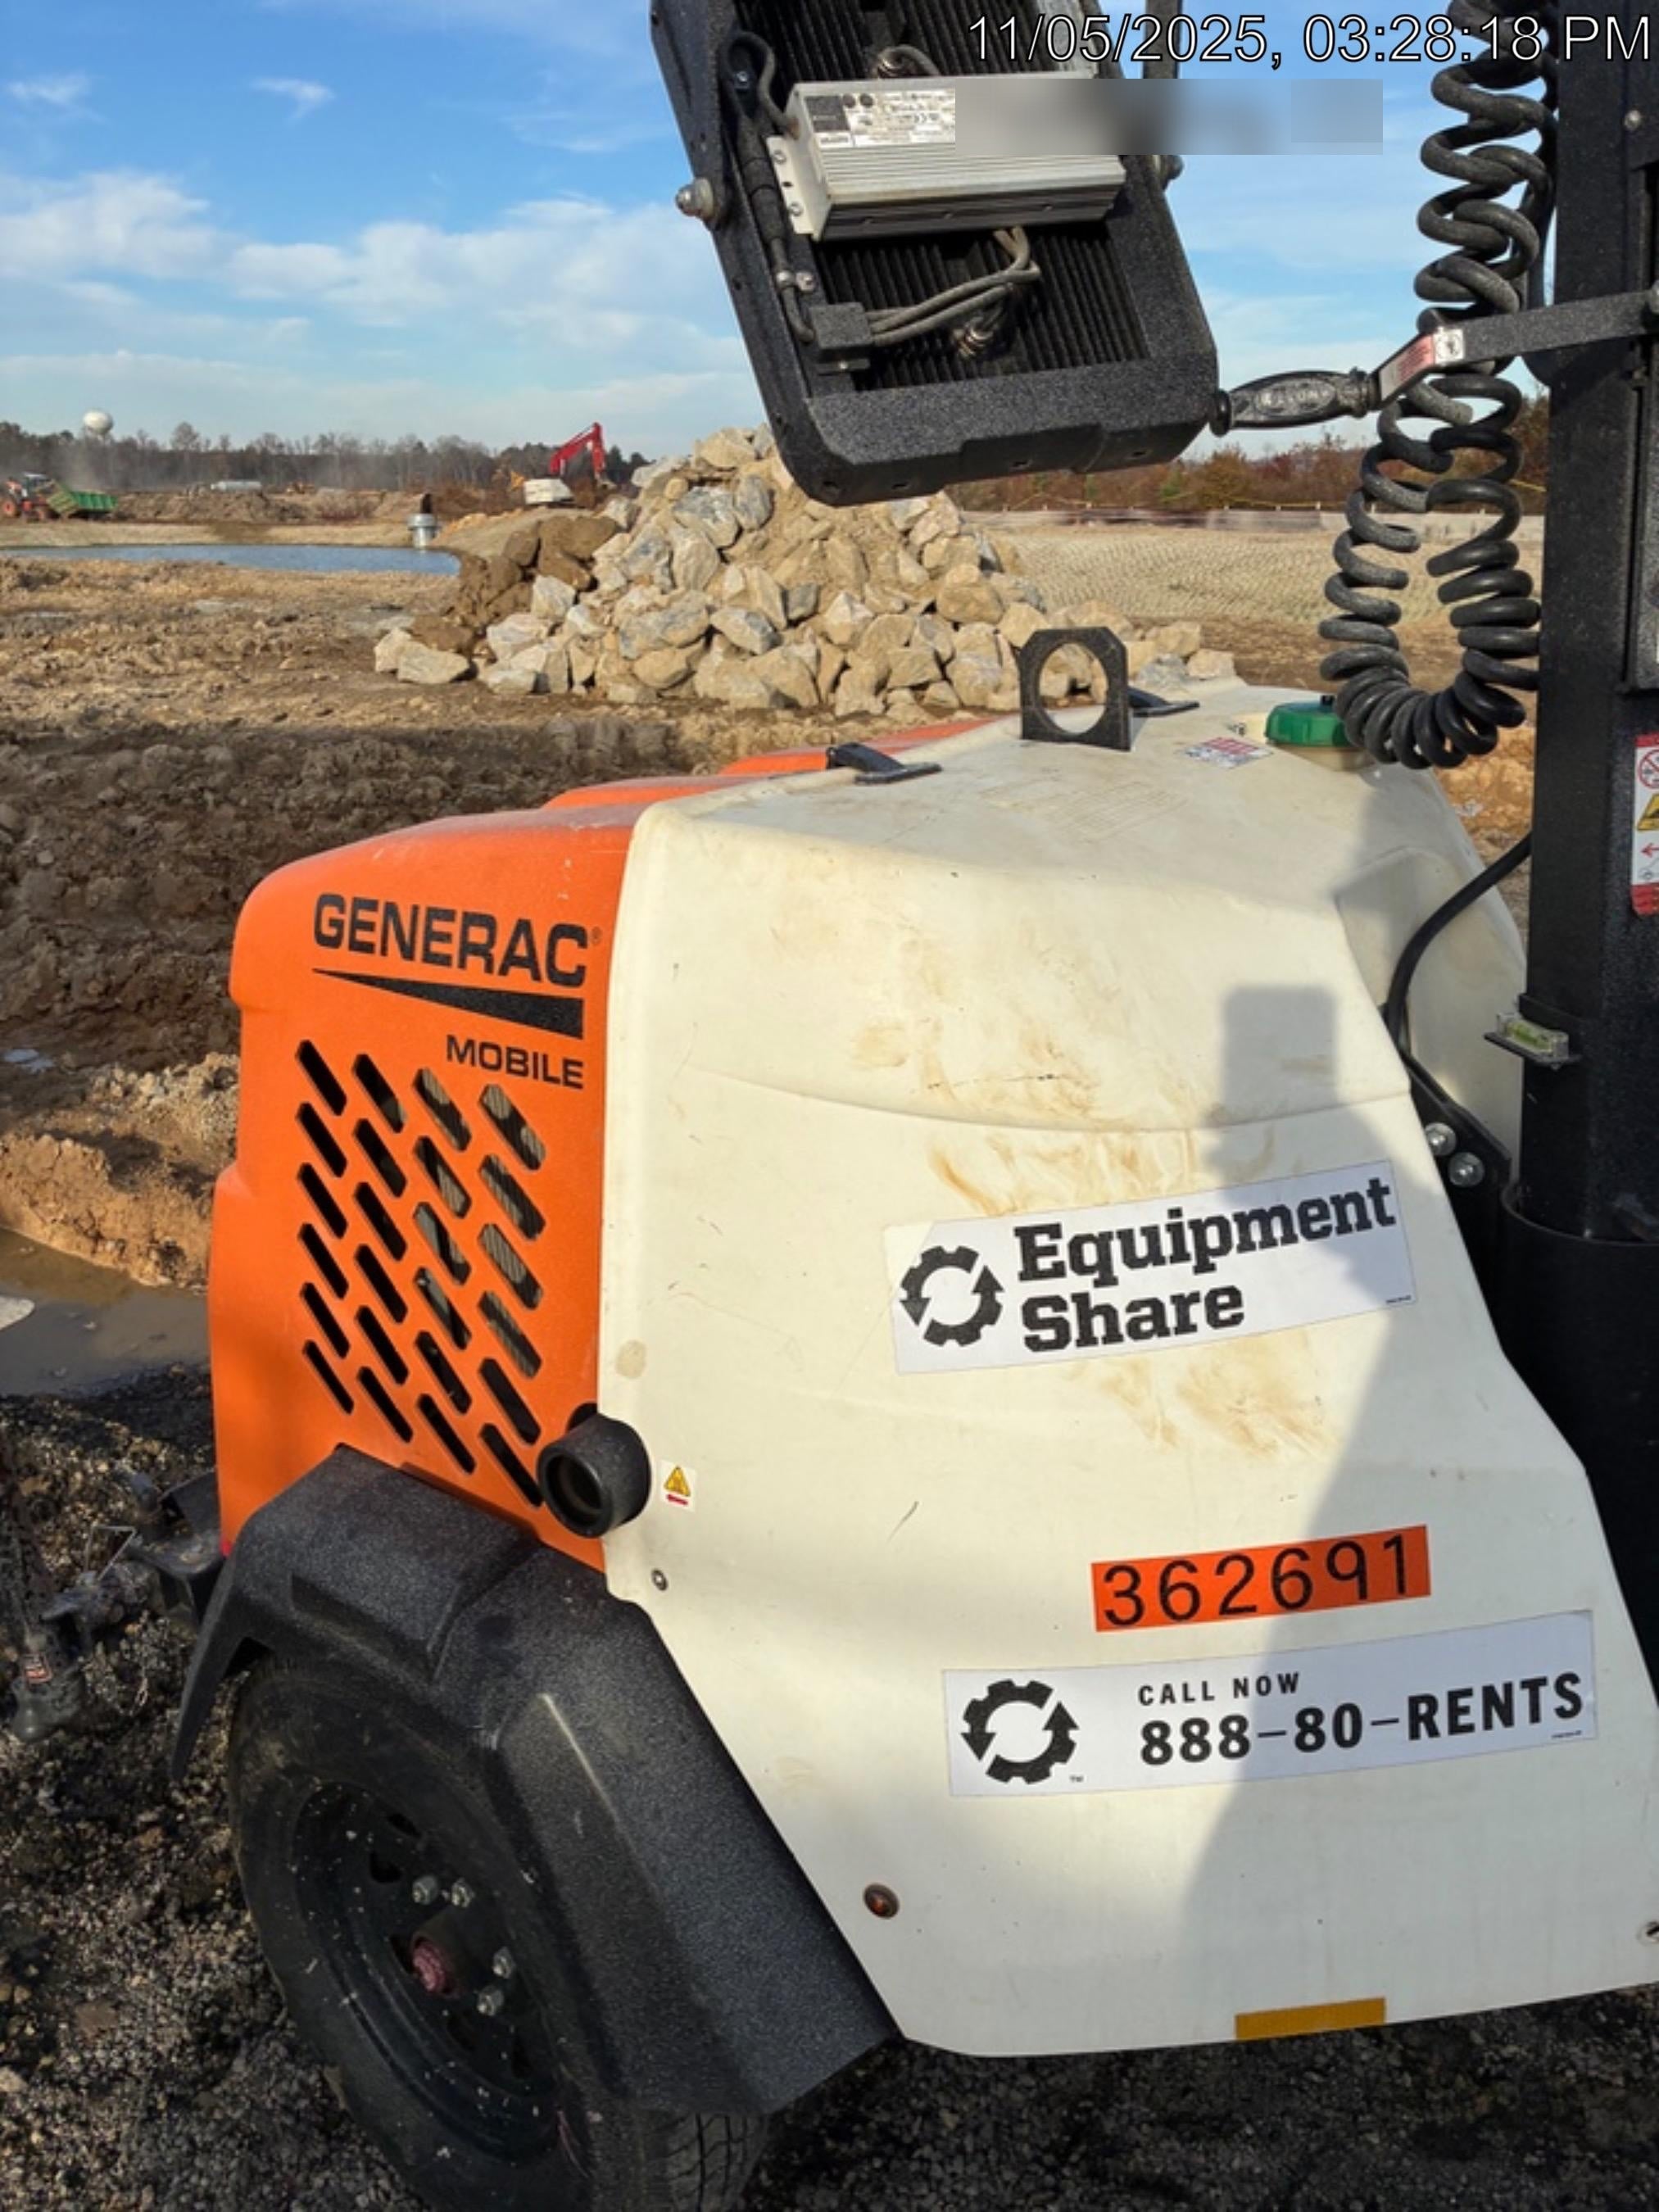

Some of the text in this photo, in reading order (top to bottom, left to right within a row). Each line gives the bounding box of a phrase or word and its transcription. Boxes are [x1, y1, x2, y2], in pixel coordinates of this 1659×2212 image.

[314, 893, 588, 987] GENERAC
[446, 1034, 584, 1090] MOBILE
[1014, 1177, 1396, 1287] Equipment
[1021, 1285, 1245, 1353] Share
[1103, 1535, 1408, 1627] 362691
[1138, 1672, 1301, 1707] CALL NOW
[1140, 1671, 1584, 1766] 888-80-RENTS
